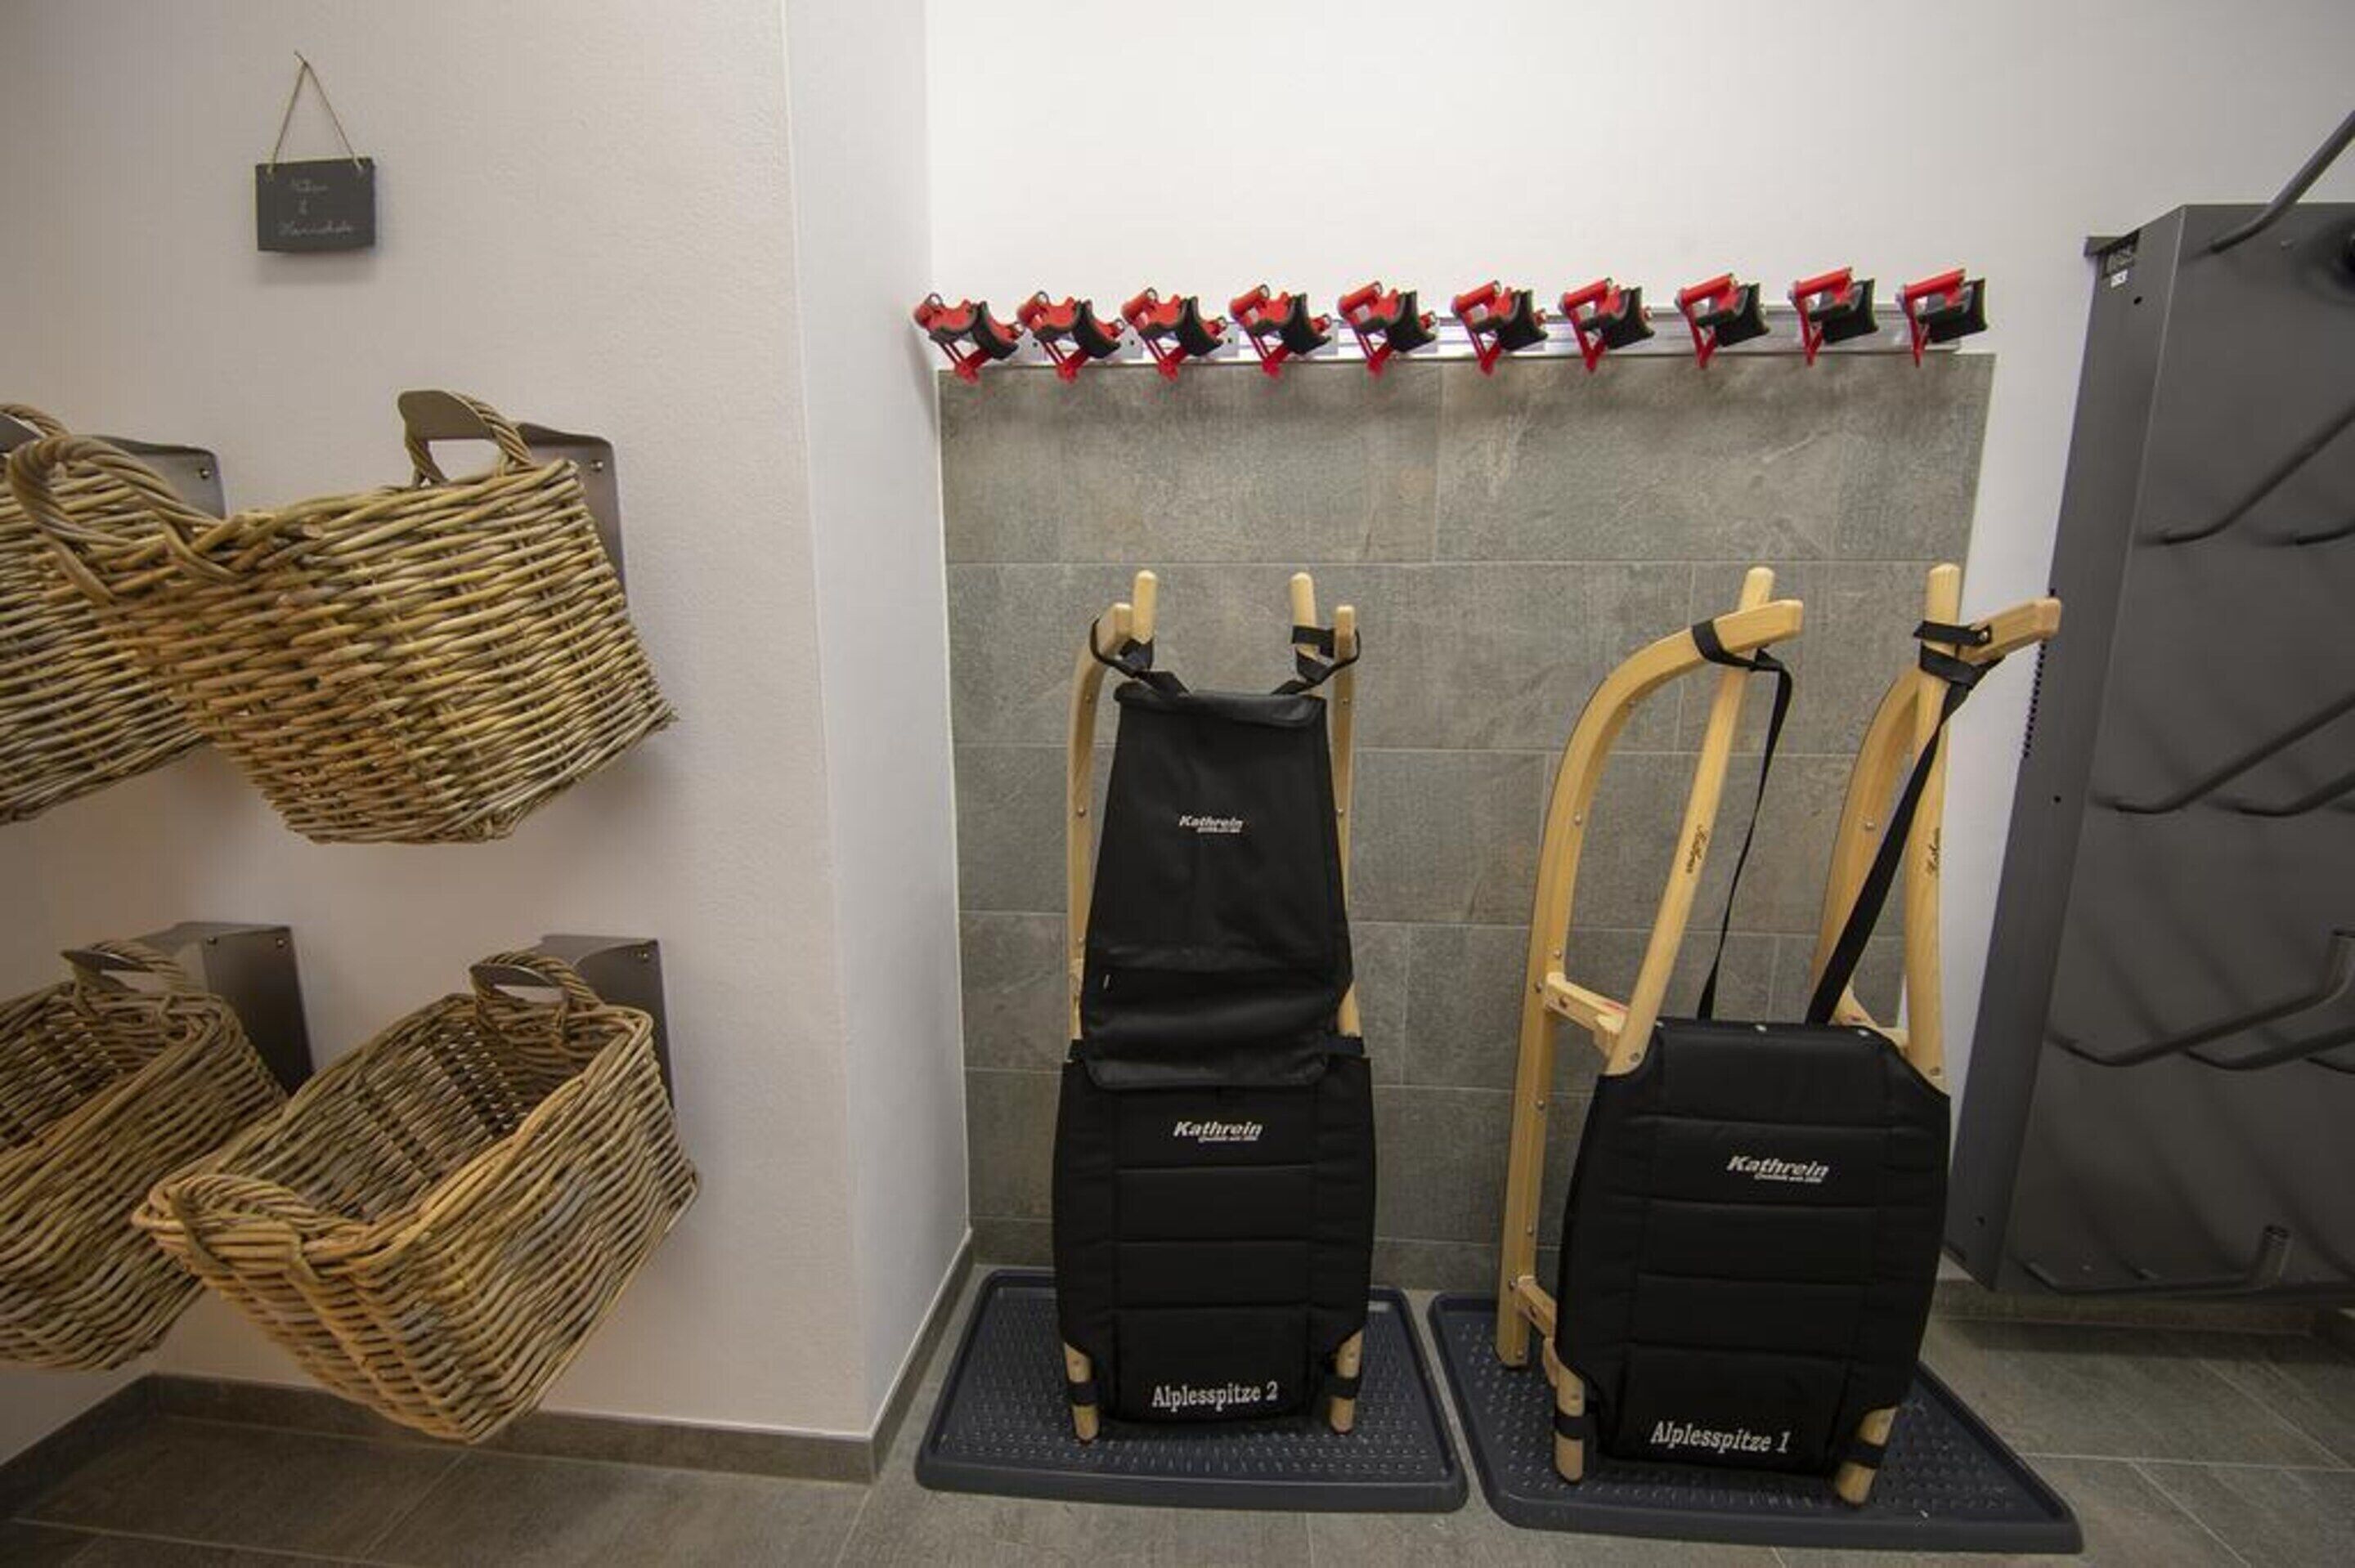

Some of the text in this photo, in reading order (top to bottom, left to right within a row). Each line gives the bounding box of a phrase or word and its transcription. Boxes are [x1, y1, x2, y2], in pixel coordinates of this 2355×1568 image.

[1179, 815, 1243, 828] Kathrein
[1173, 1121, 1263, 1136] Kathrein
[1726, 1155, 1829, 1177] Kathrein
[1151, 1380, 1279, 1412] Alplesspitze 2
[1649, 1420, 1791, 1454] Alplesspitze 1
